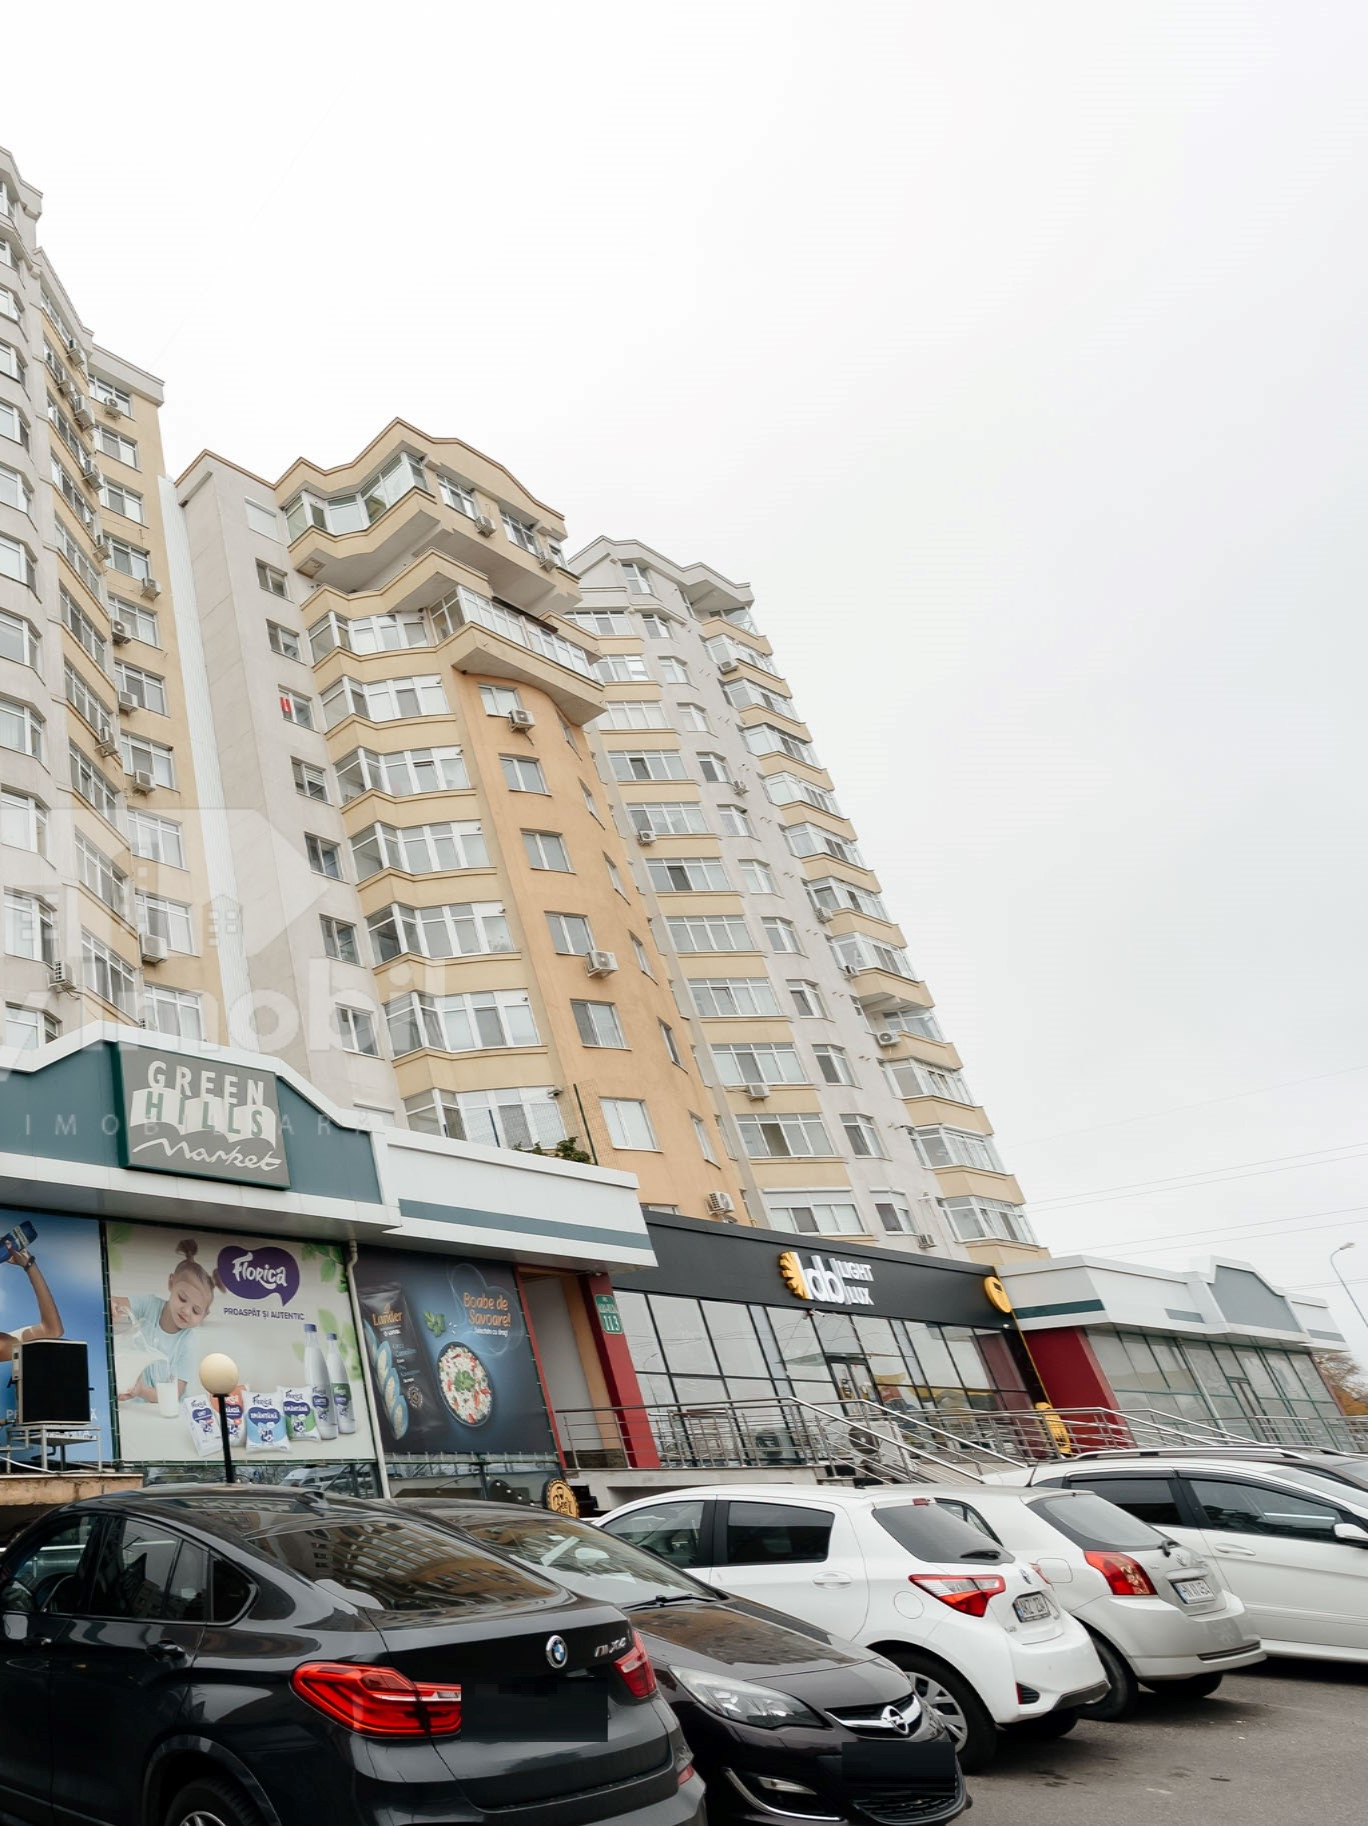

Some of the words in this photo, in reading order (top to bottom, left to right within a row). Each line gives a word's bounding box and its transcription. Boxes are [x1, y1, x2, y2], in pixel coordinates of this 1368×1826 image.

[147, 1060, 265, 1105] GREEN
[145, 1090, 263, 1138] HILLS
[132, 1137, 282, 1171] Market
[231, 1252, 288, 1290] Florica
[840, 1260, 874, 1281] LIGHT
[463, 1292, 495, 1309] Boabe
[496, 1294, 508, 1310] de
[848, 1286, 875, 1305] LUX
[271, 1312, 305, 1321] AUTENTIC
